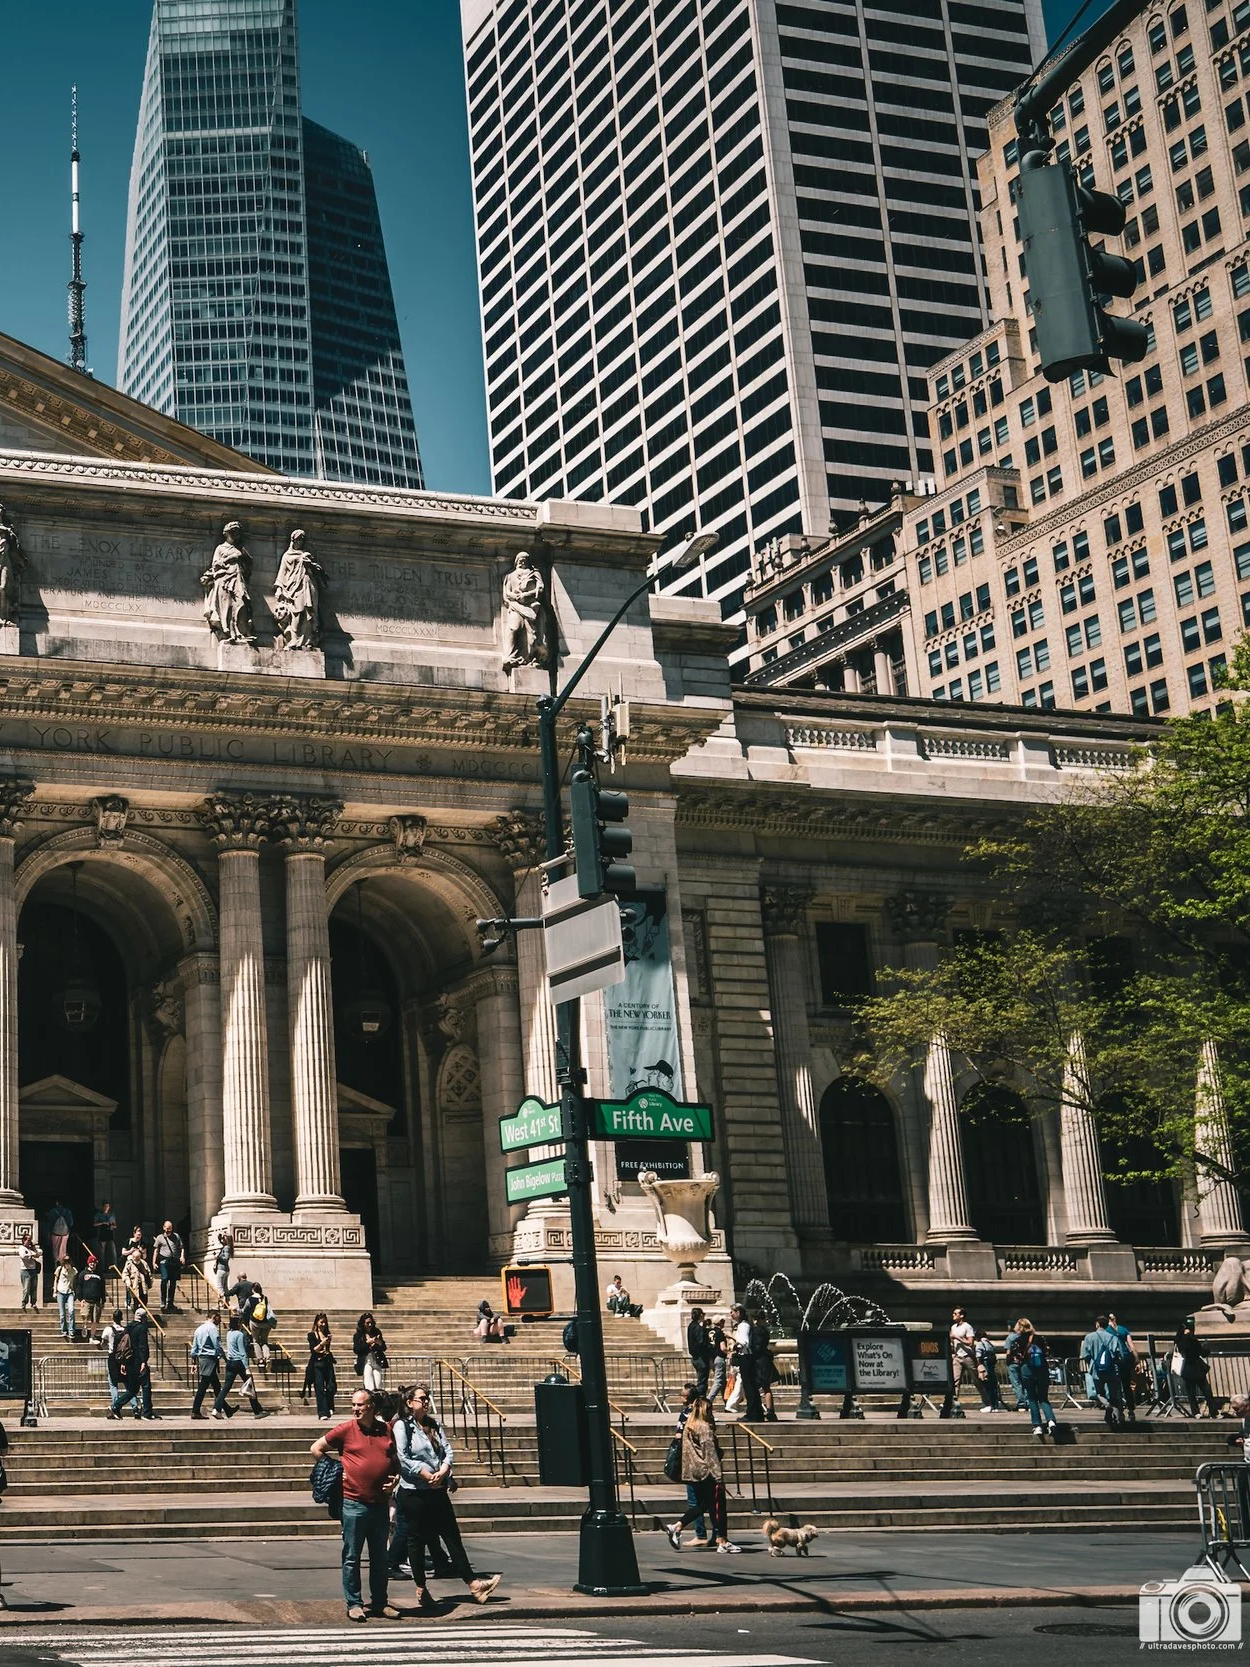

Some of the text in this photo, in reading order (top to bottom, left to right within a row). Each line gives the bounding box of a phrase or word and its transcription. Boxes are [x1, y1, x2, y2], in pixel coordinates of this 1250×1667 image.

[31, 534, 194, 561] THE LENOX LIBRARY
[67, 567, 159, 583] JAMES LENOX
[330, 561, 480, 588] THE TILDEN TRUST
[33, 727, 112, 750] YORK
[139, 732, 245, 760] PUBLIC
[272, 740, 395, 770] LIBRARY
[453, 758, 540, 777] MDCCCCI
[609, 1009, 672, 1019] THE NEW YORKER
[505, 1114, 559, 1143] West 41st St
[612, 1110, 694, 1132] Fifth Ave
[621, 1161, 684, 1170] FREE EXHIBITION
[510, 1176, 526, 1191] John
[525, 1171, 551, 1191] Bigelow
[857, 1342, 884, 1352] Explore
[857, 1351, 893, 1359] What's On
[859, 1360, 875, 1368] Now
[859, 1368, 899, 1379] the Library!
